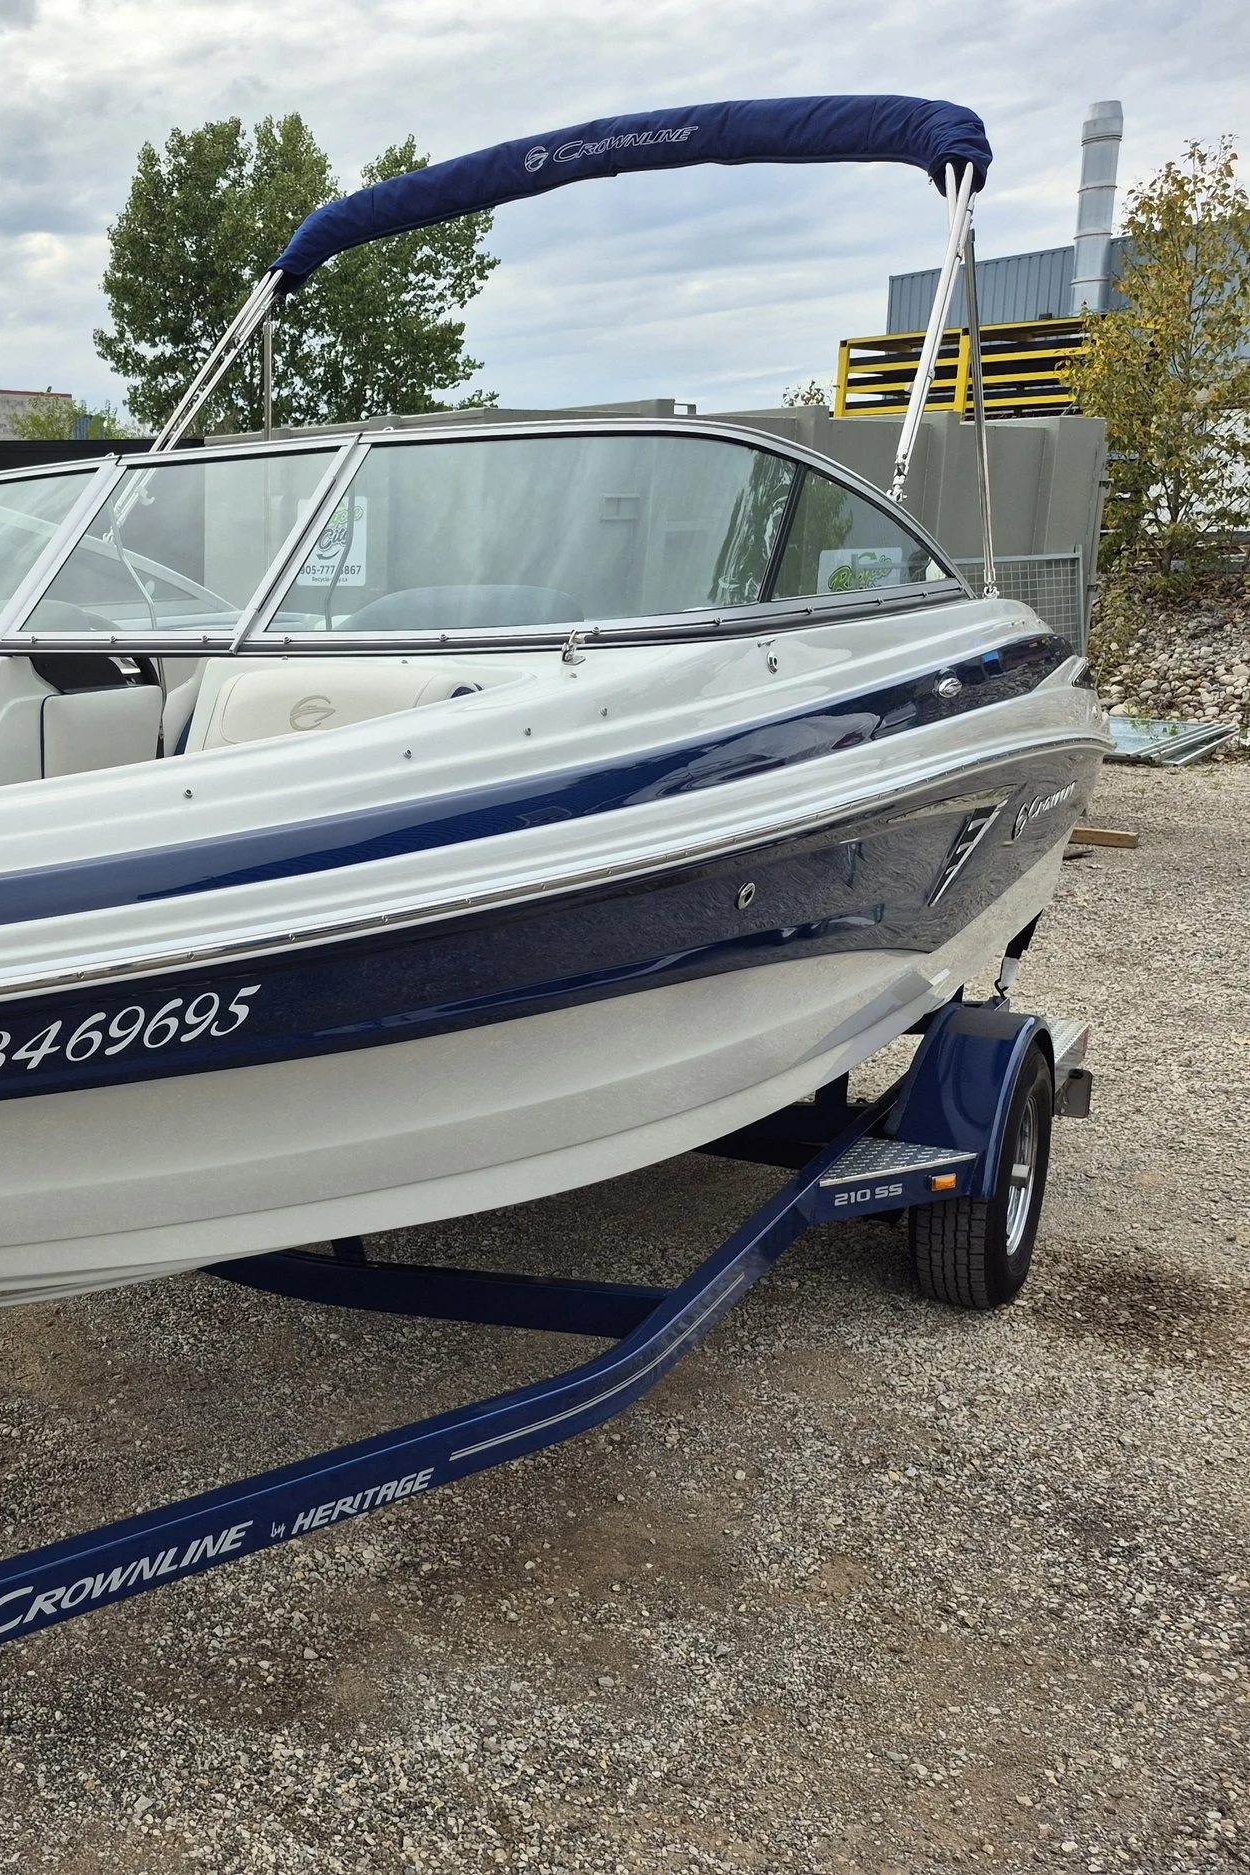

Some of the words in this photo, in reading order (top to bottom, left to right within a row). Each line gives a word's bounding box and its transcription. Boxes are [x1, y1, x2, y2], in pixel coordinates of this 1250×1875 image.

[552, 125, 699, 163] CROWNLINE
[300, 565, 362, 575] 905-777867
[834, 1188, 871, 1207] 210
[875, 1183, 903, 1199] SS
[270, 1520, 286, 1539] by
[291, 1467, 434, 1536] HERITAGE
